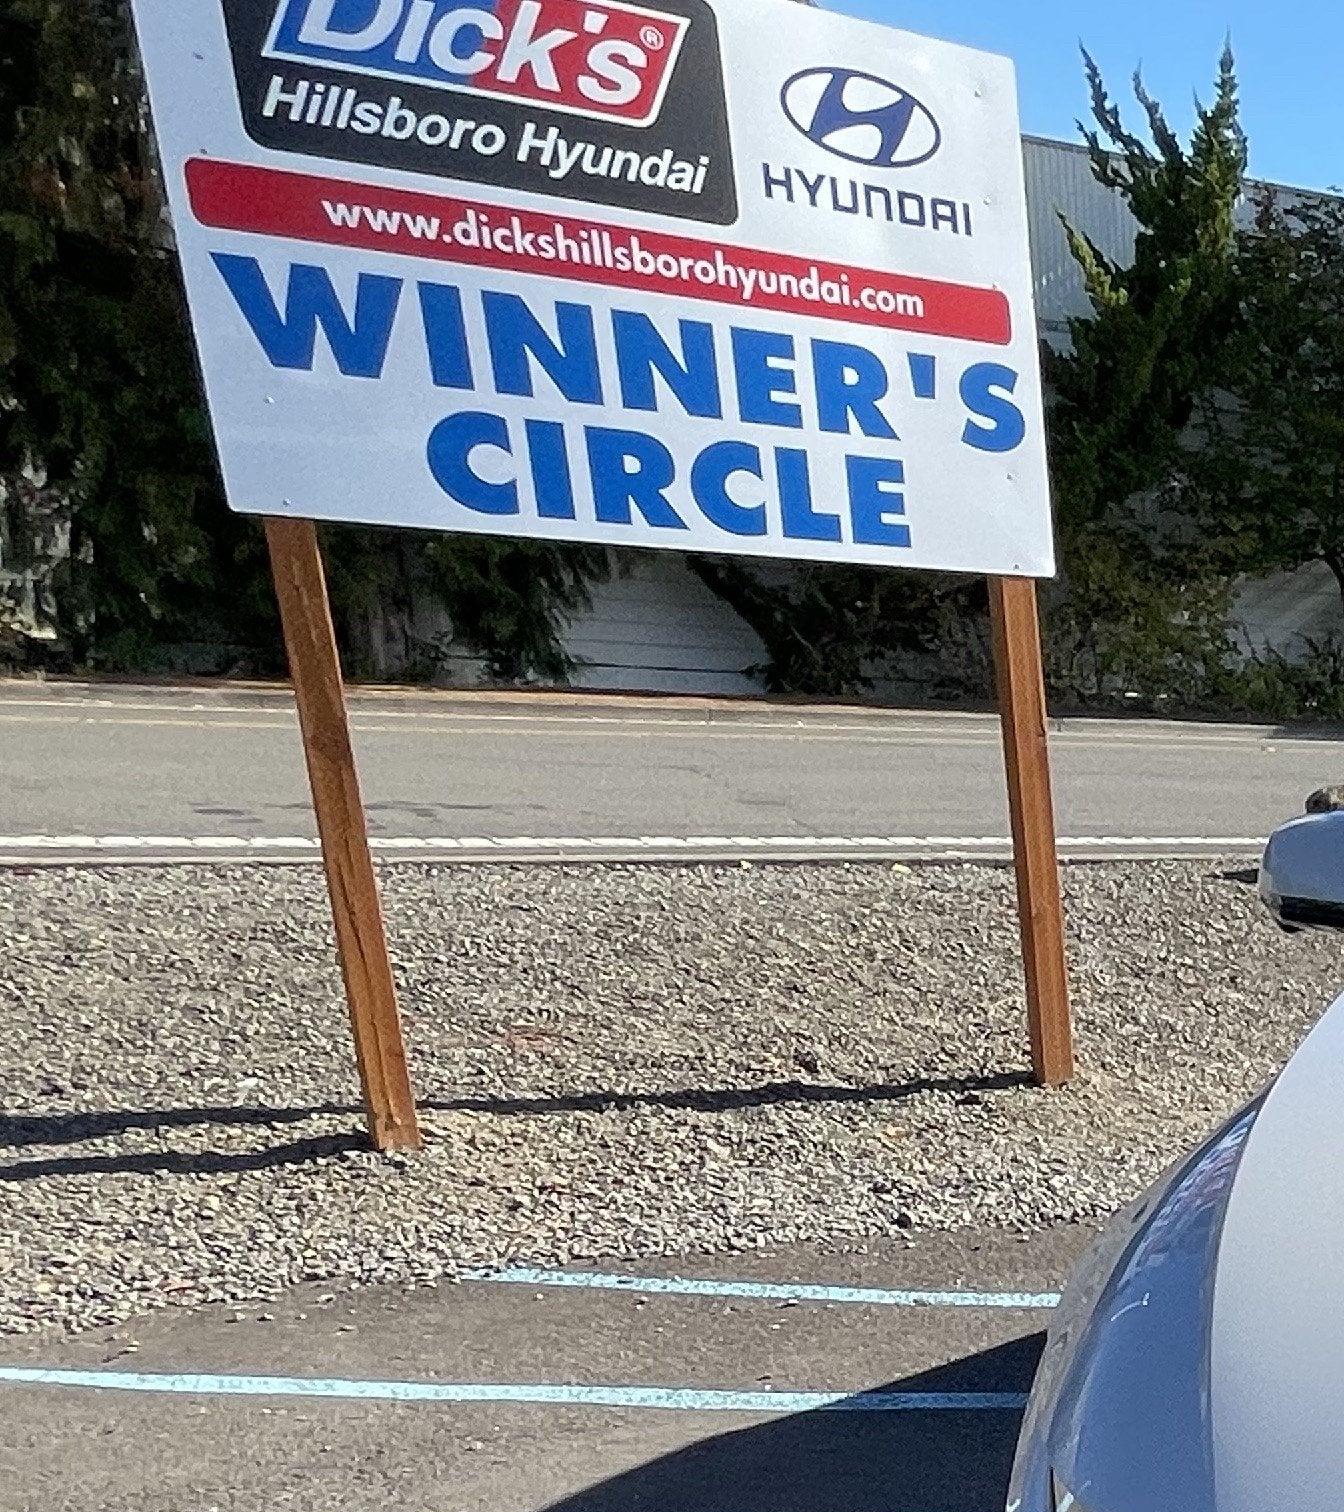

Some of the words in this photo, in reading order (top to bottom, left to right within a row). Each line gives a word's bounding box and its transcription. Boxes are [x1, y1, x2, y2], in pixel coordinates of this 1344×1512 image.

[261, 75, 505, 155] Hillsboro
[516, 121, 710, 194] Hyundai
[321, 200, 925, 318] www.dickshillsborohyundai.com
[761, 162, 973, 237] HYUNDAI
[210, 251, 1027, 453] WINNER'S
[426, 411, 912, 548] CIRCLE
